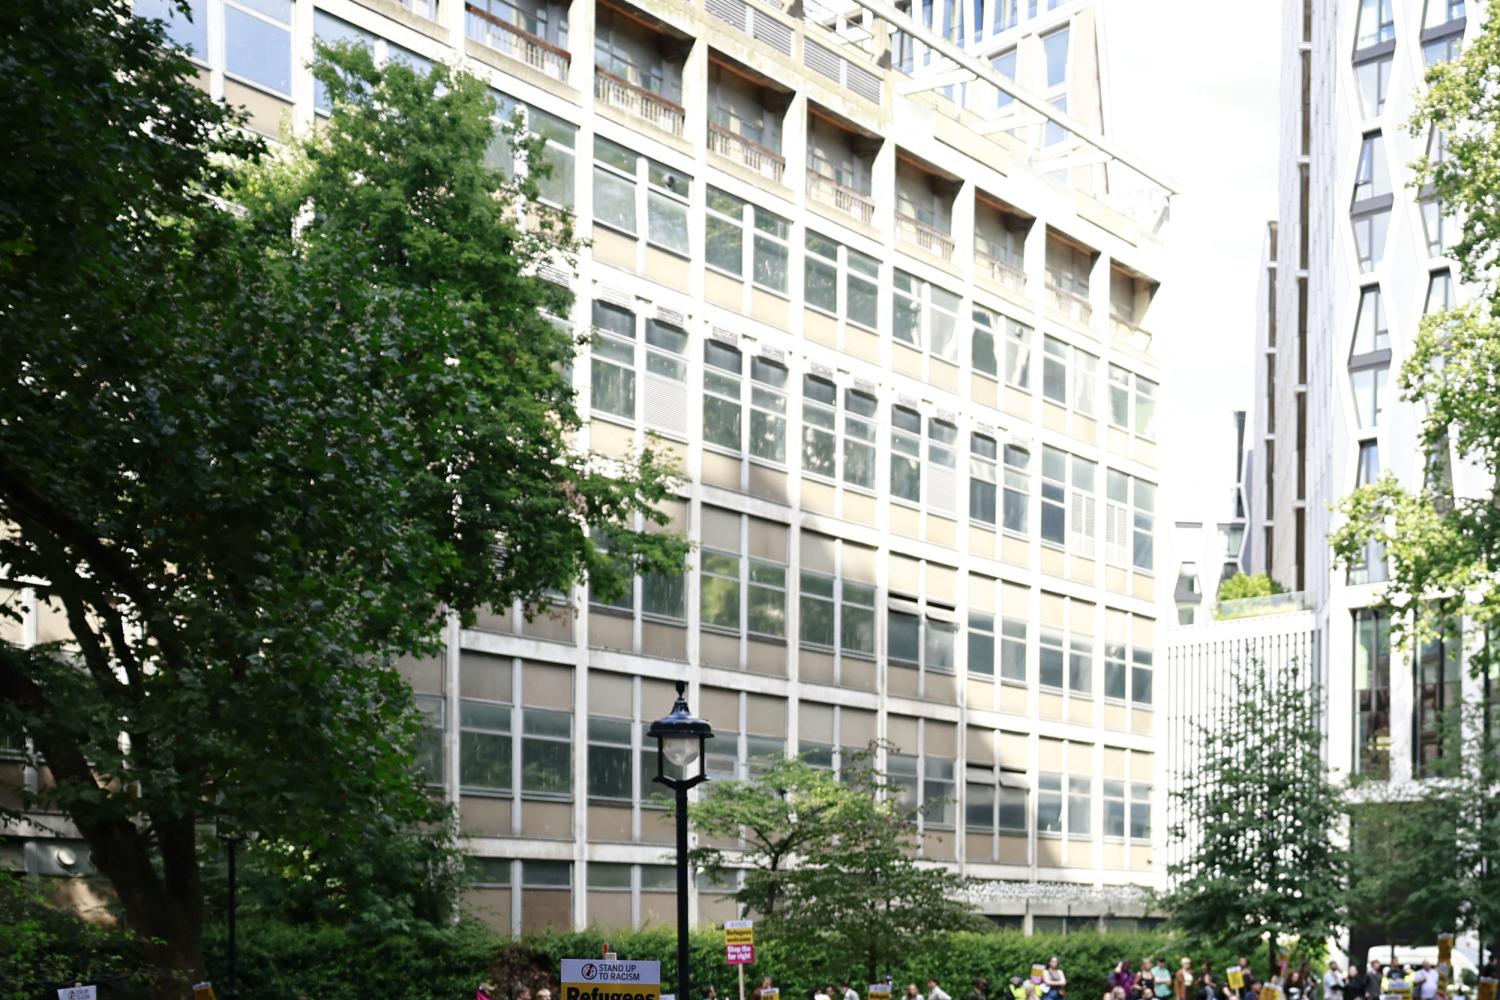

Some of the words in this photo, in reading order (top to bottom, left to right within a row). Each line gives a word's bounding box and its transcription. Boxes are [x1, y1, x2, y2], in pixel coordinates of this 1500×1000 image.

[598, 964, 624, 973] STAND
[626, 964, 637, 974] UP
[598, 972, 608, 980] TO
[610, 972, 640, 982] RACISM
